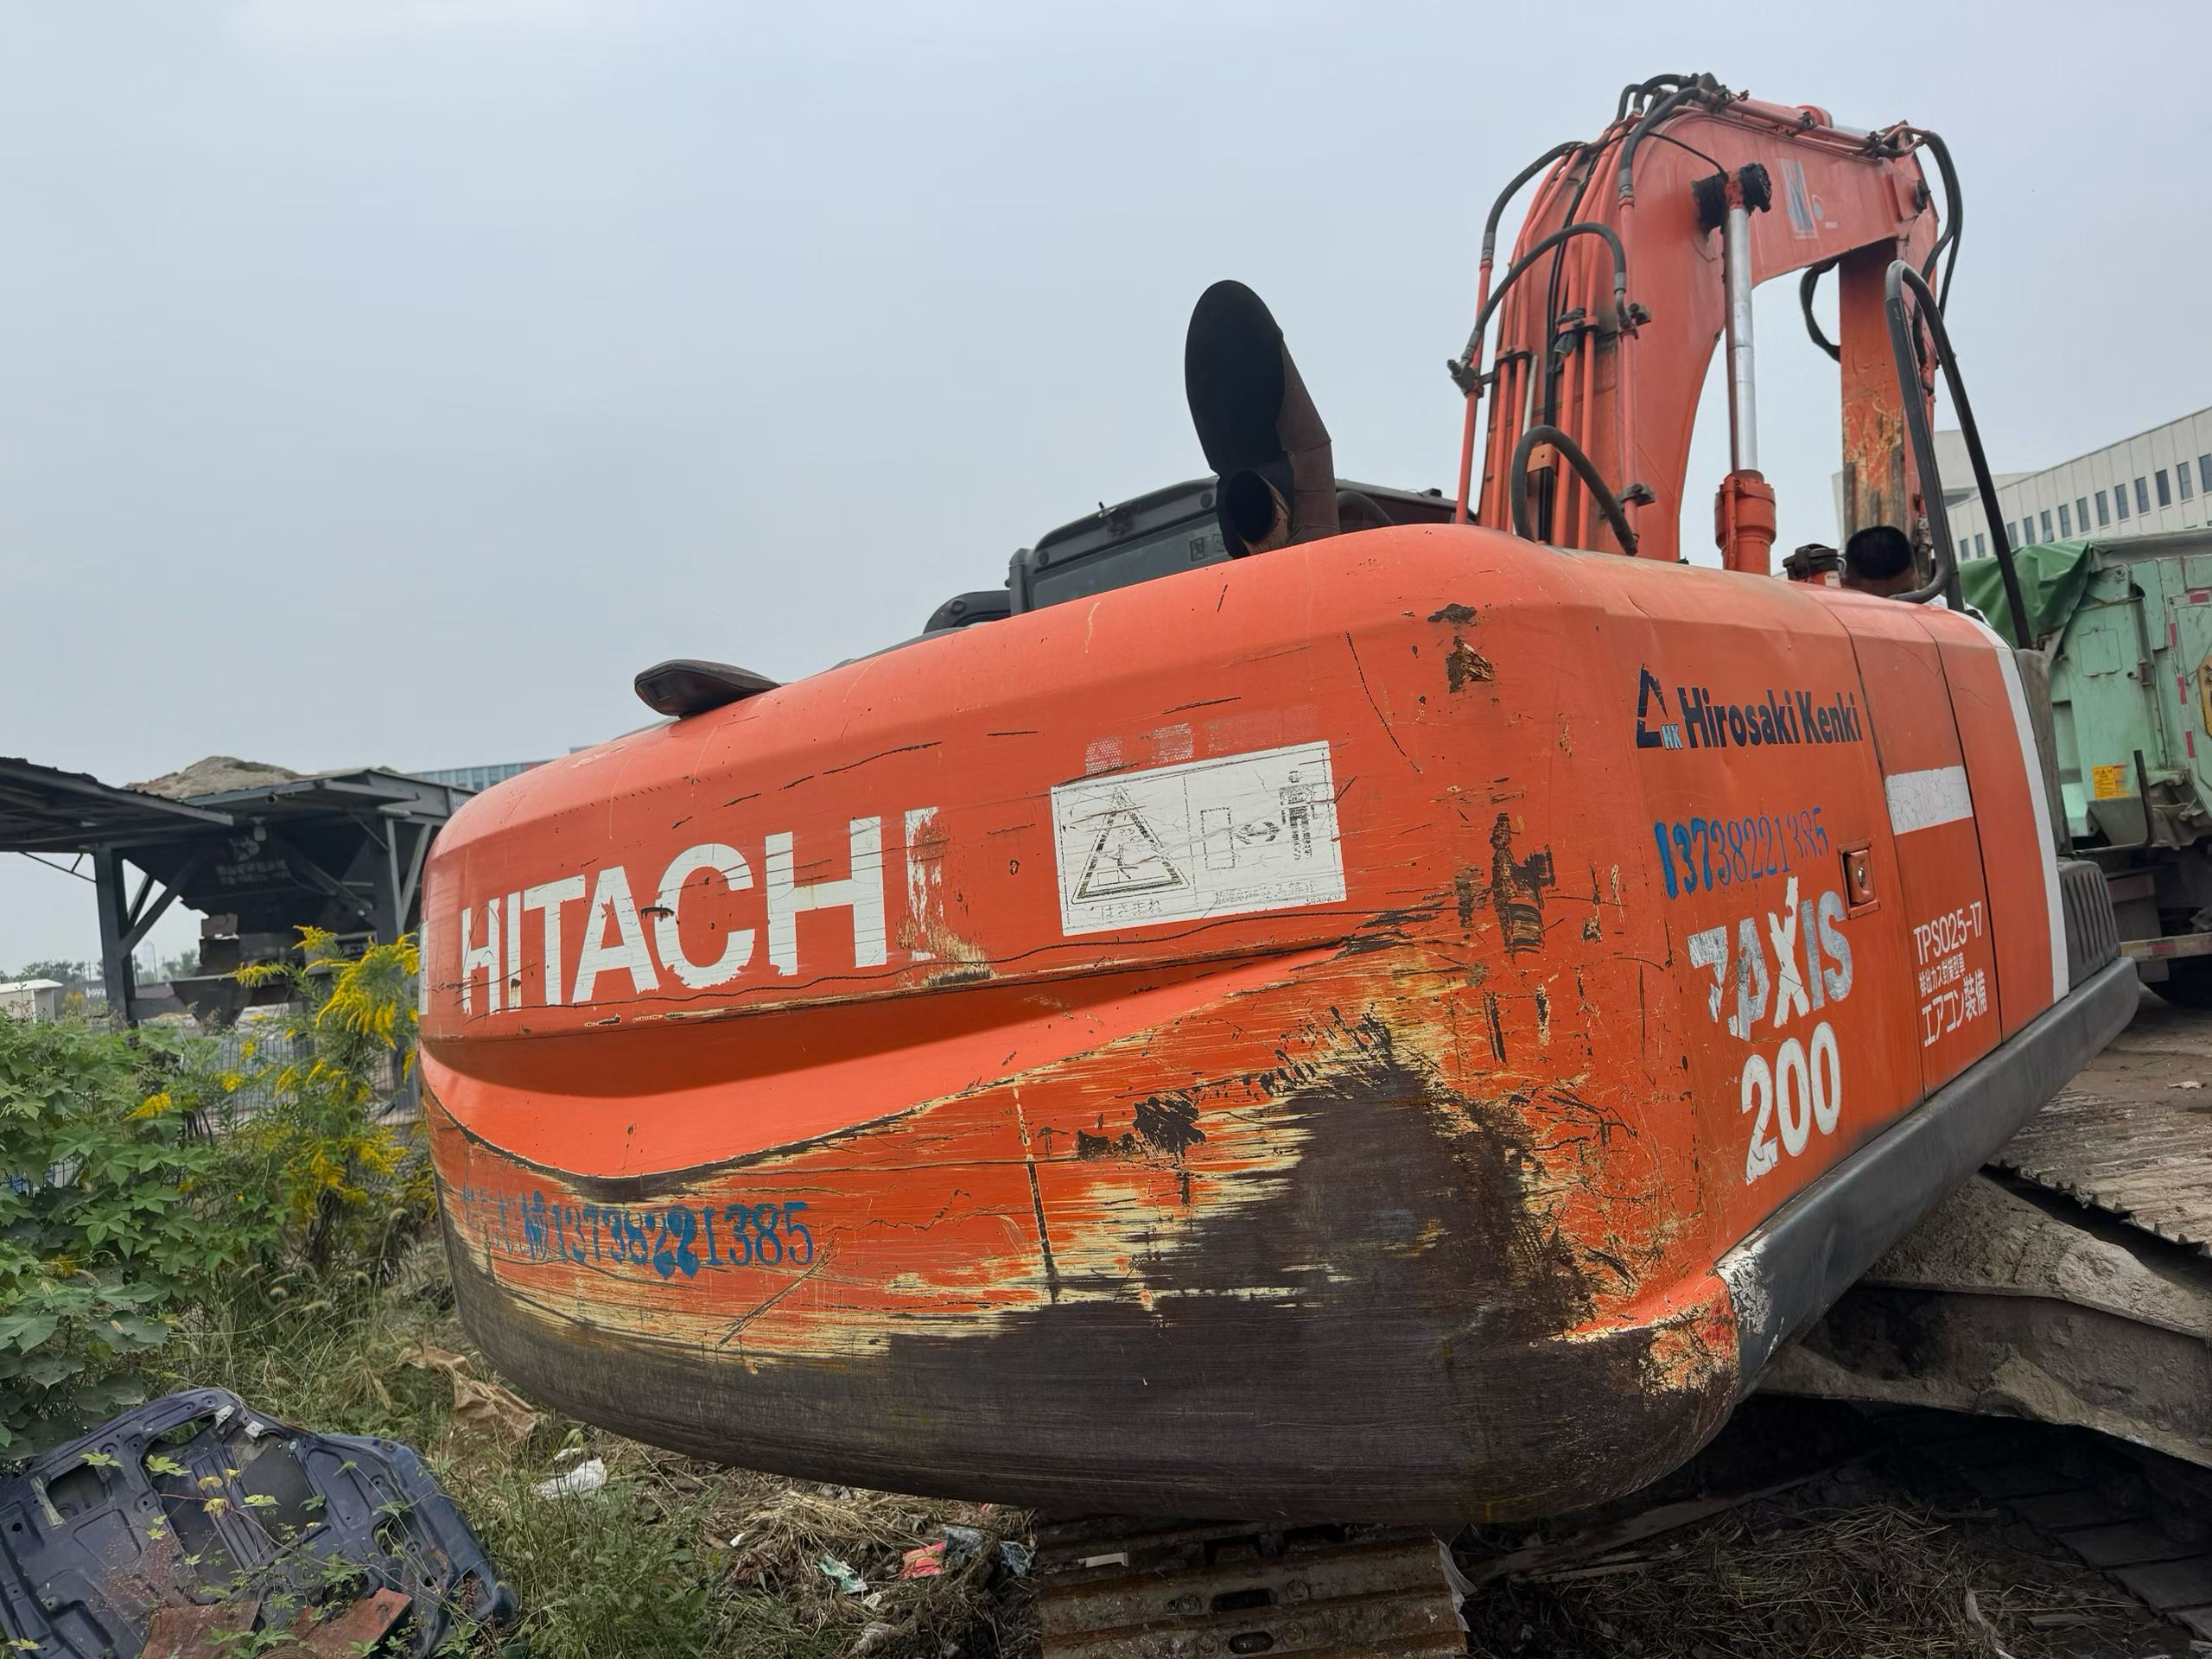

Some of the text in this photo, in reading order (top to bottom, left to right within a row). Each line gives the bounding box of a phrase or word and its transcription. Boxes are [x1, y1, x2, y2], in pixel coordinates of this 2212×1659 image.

[1676, 686, 1864, 750] Hirosaki Kenki
[1654, 806, 1829, 899] 13738221385
[1913, 900, 1982, 965] TPS025-17
[1922, 967, 1987, 1048] エアコン装備
[1741, 1021, 1841, 1185] 200
[551, 1201, 814, 1279] 13738221385
